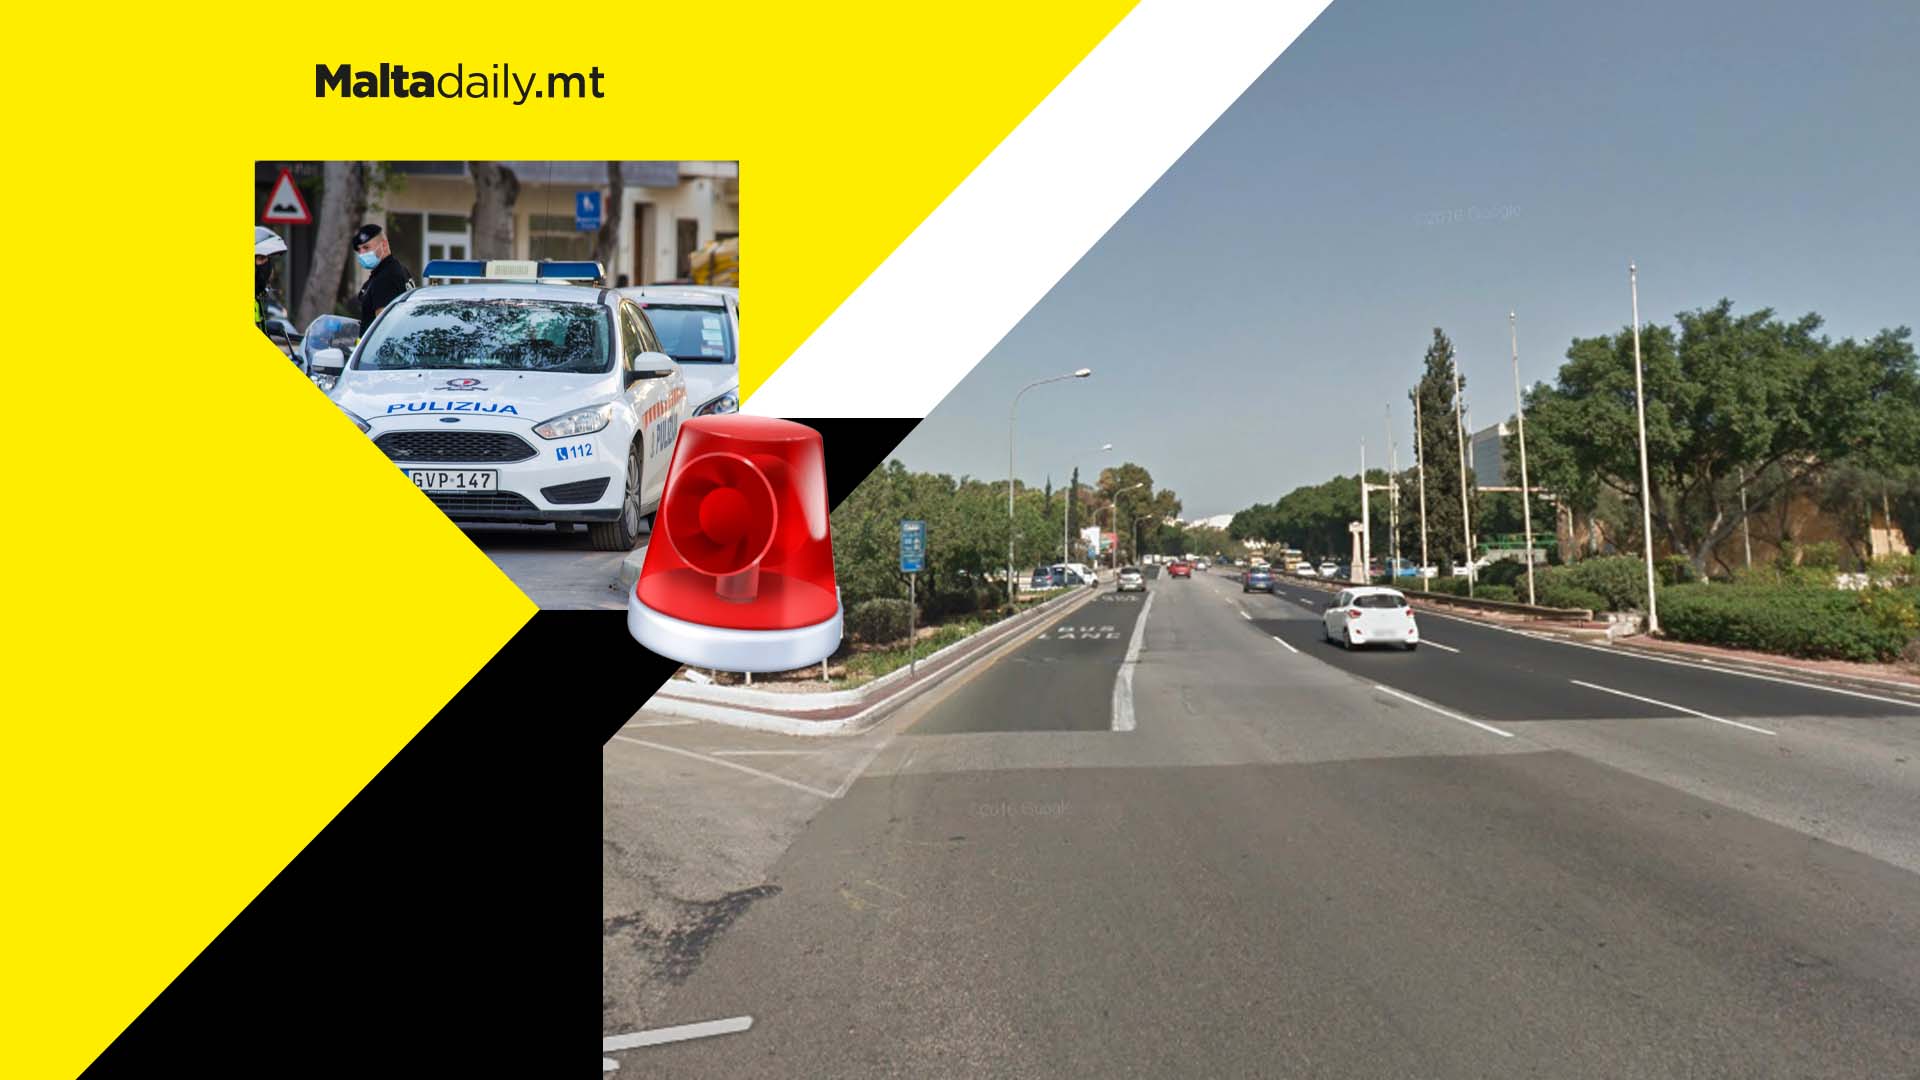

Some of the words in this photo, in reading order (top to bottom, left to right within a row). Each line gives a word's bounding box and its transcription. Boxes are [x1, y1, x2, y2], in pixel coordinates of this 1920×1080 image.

[386, 401, 519, 415] PULIZIJA
[569, 442, 593, 459] 112
[1057, 625, 1116, 633] BUS
[1037, 632, 1121, 640] LANE
